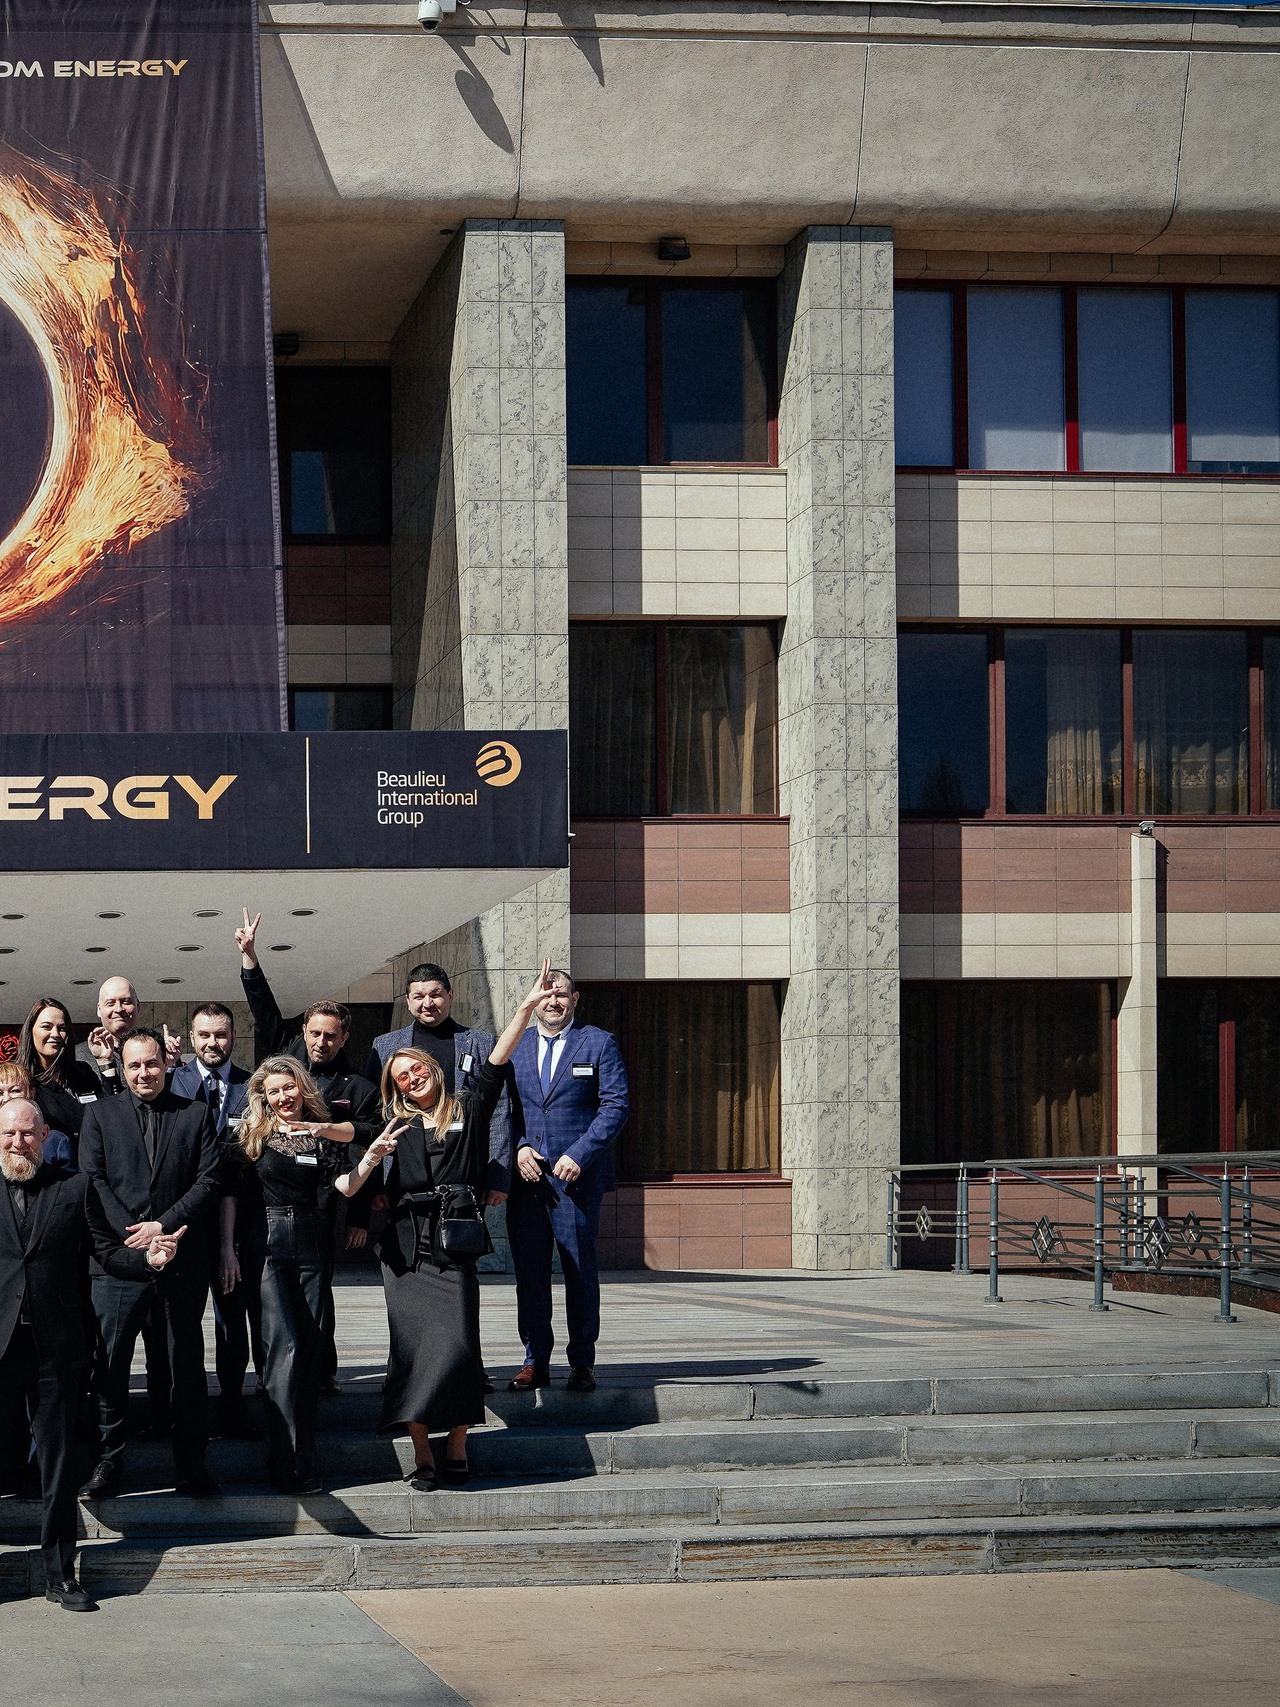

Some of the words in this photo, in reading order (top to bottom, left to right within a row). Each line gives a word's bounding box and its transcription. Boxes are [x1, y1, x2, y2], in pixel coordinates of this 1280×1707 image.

[53, 59, 188, 78] ENERGY
[377, 770, 446, 788] Beaulieu
[377, 789, 478, 806] International
[377, 808, 424, 828] Group
